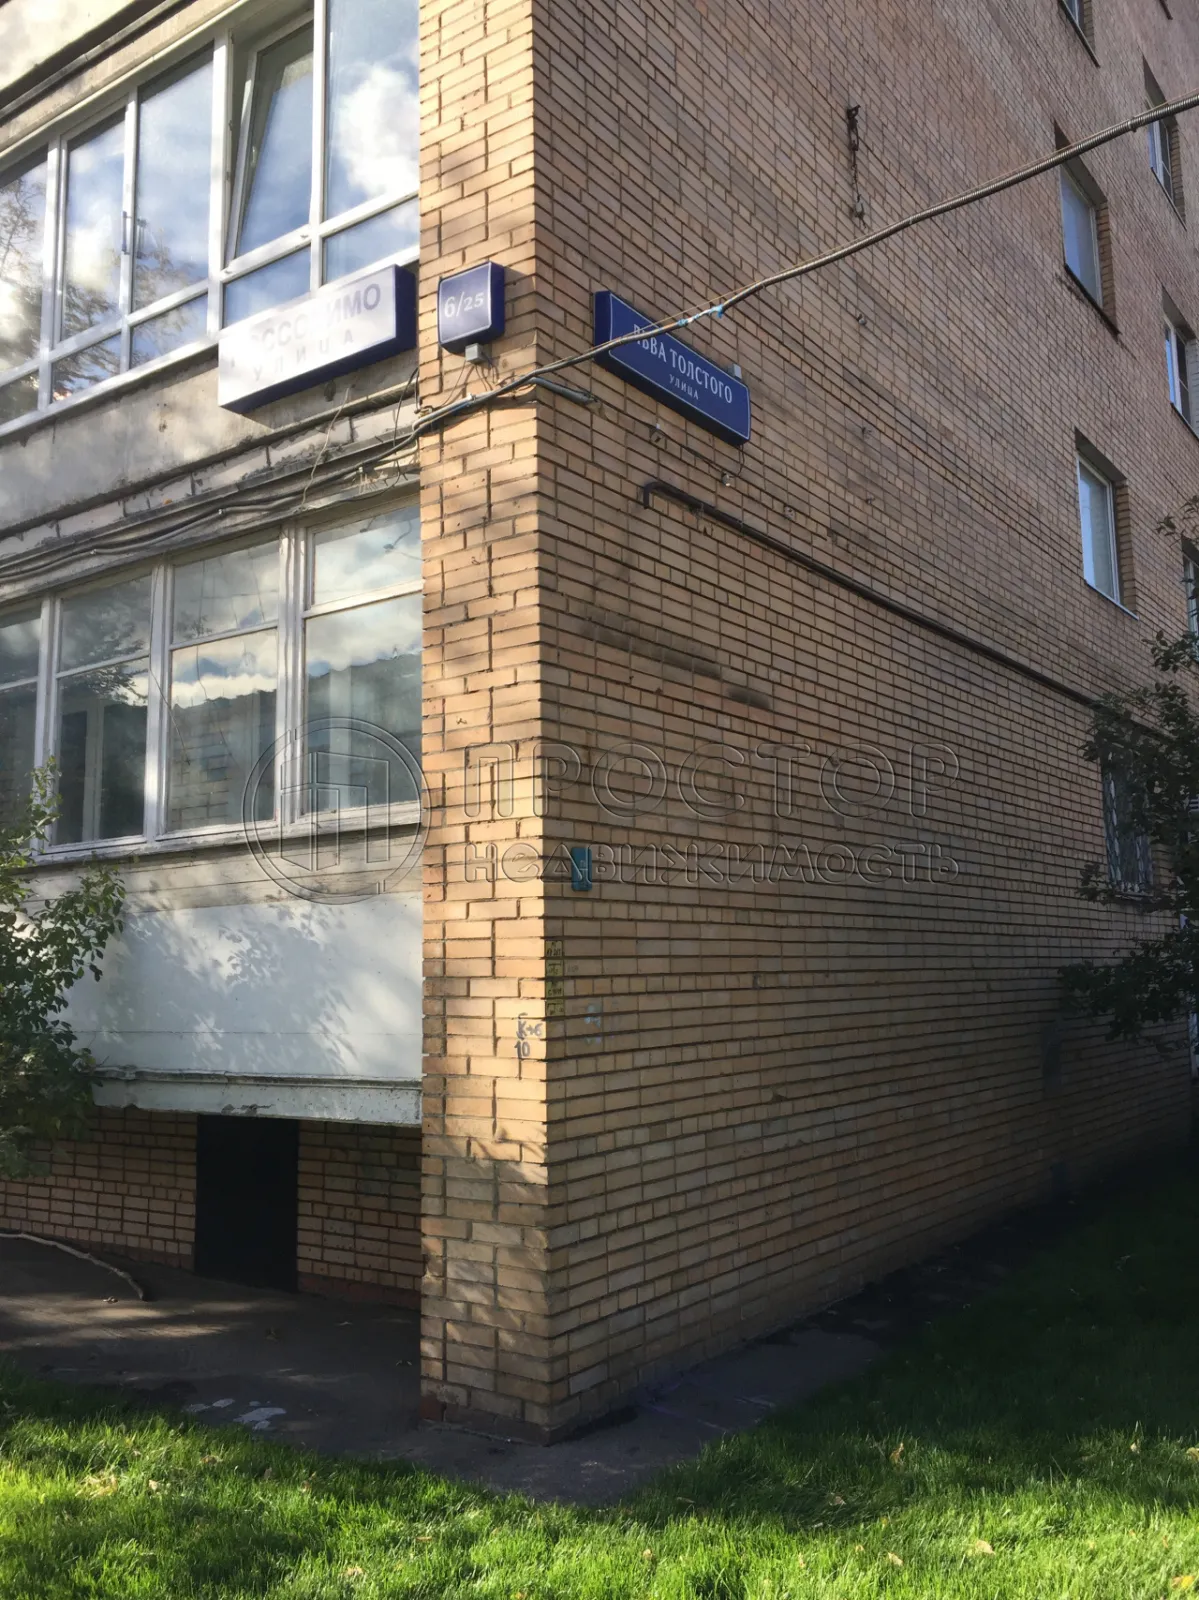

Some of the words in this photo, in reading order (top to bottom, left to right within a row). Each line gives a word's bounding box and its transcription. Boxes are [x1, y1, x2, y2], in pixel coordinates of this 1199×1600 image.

[443, 291, 485, 319] 6/25
[254, 335, 354, 381] УЛИЦА
[669, 348, 733, 404] ТОЛСТОГО
[669, 374, 699, 400] УЛИЦА
